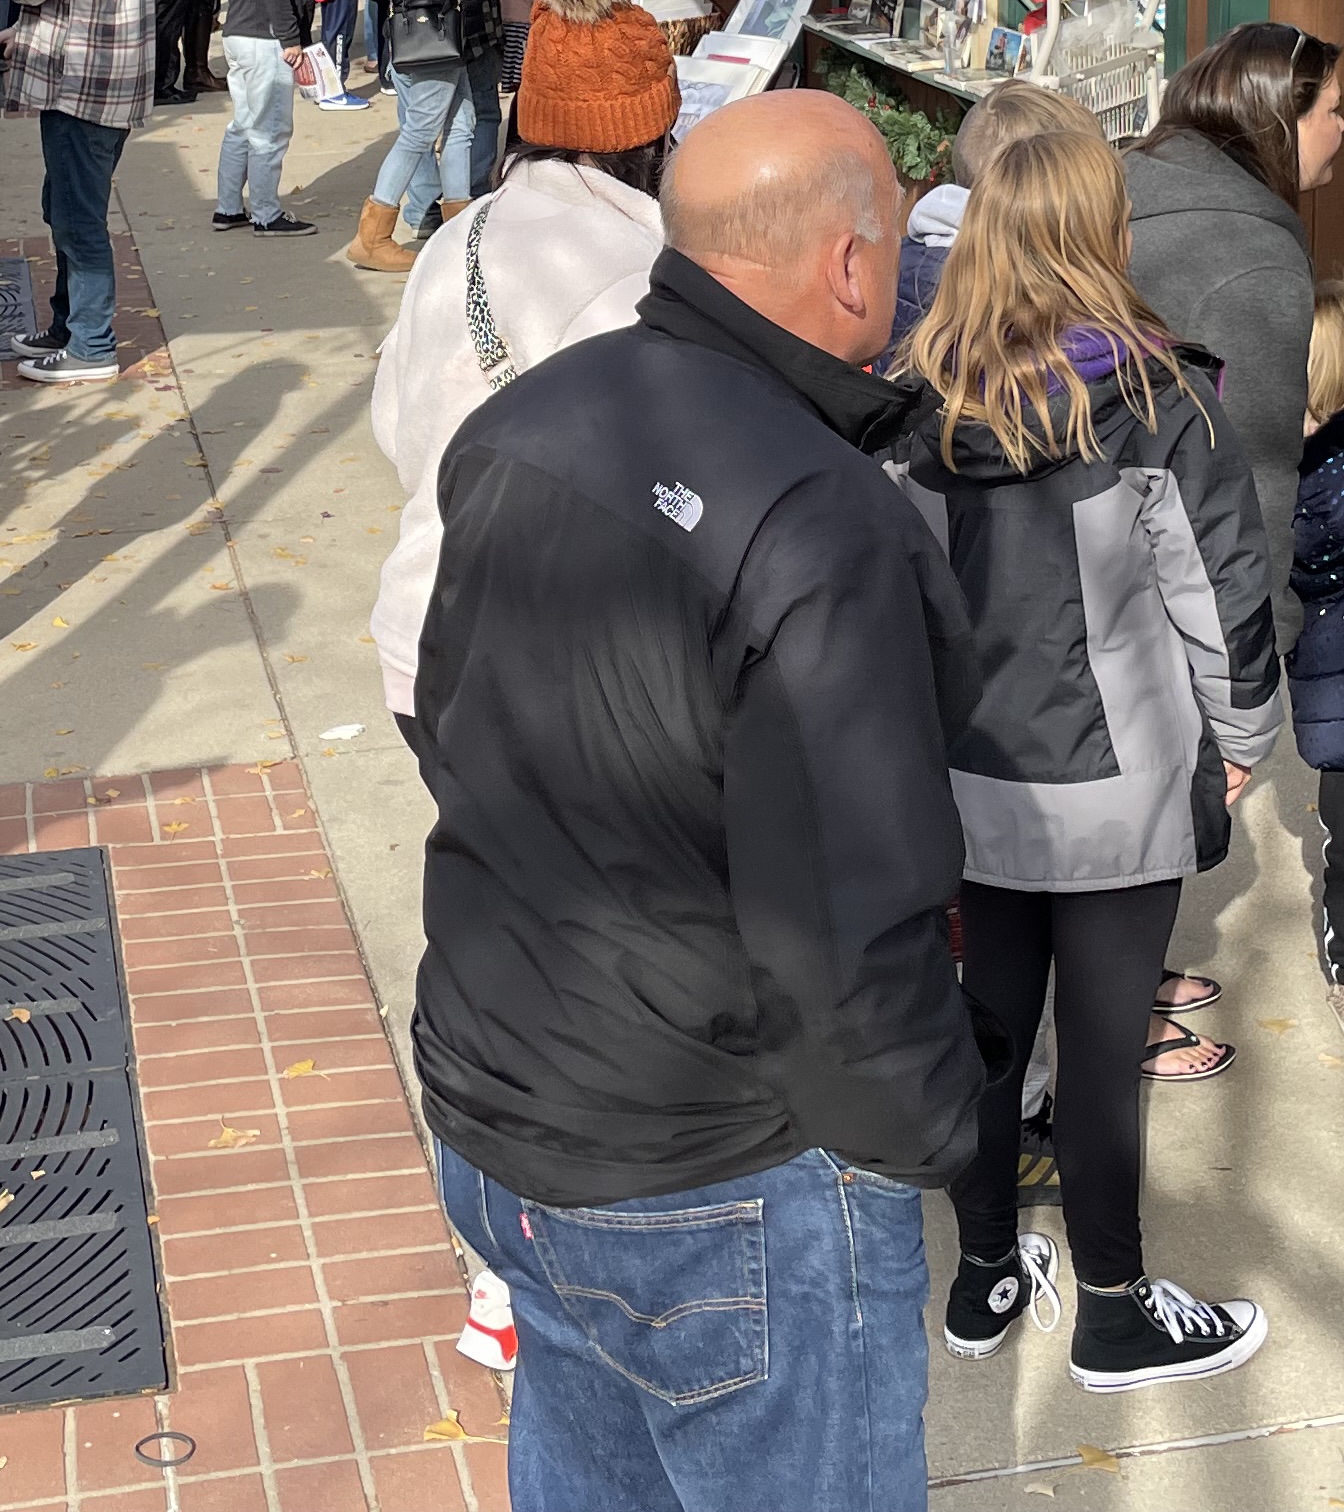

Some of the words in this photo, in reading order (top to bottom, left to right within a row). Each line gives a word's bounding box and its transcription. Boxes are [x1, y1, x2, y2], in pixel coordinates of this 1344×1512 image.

[651, 481, 688, 511] NORTH
[672, 481, 695, 502] THE
[653, 496, 681, 520] FACE
